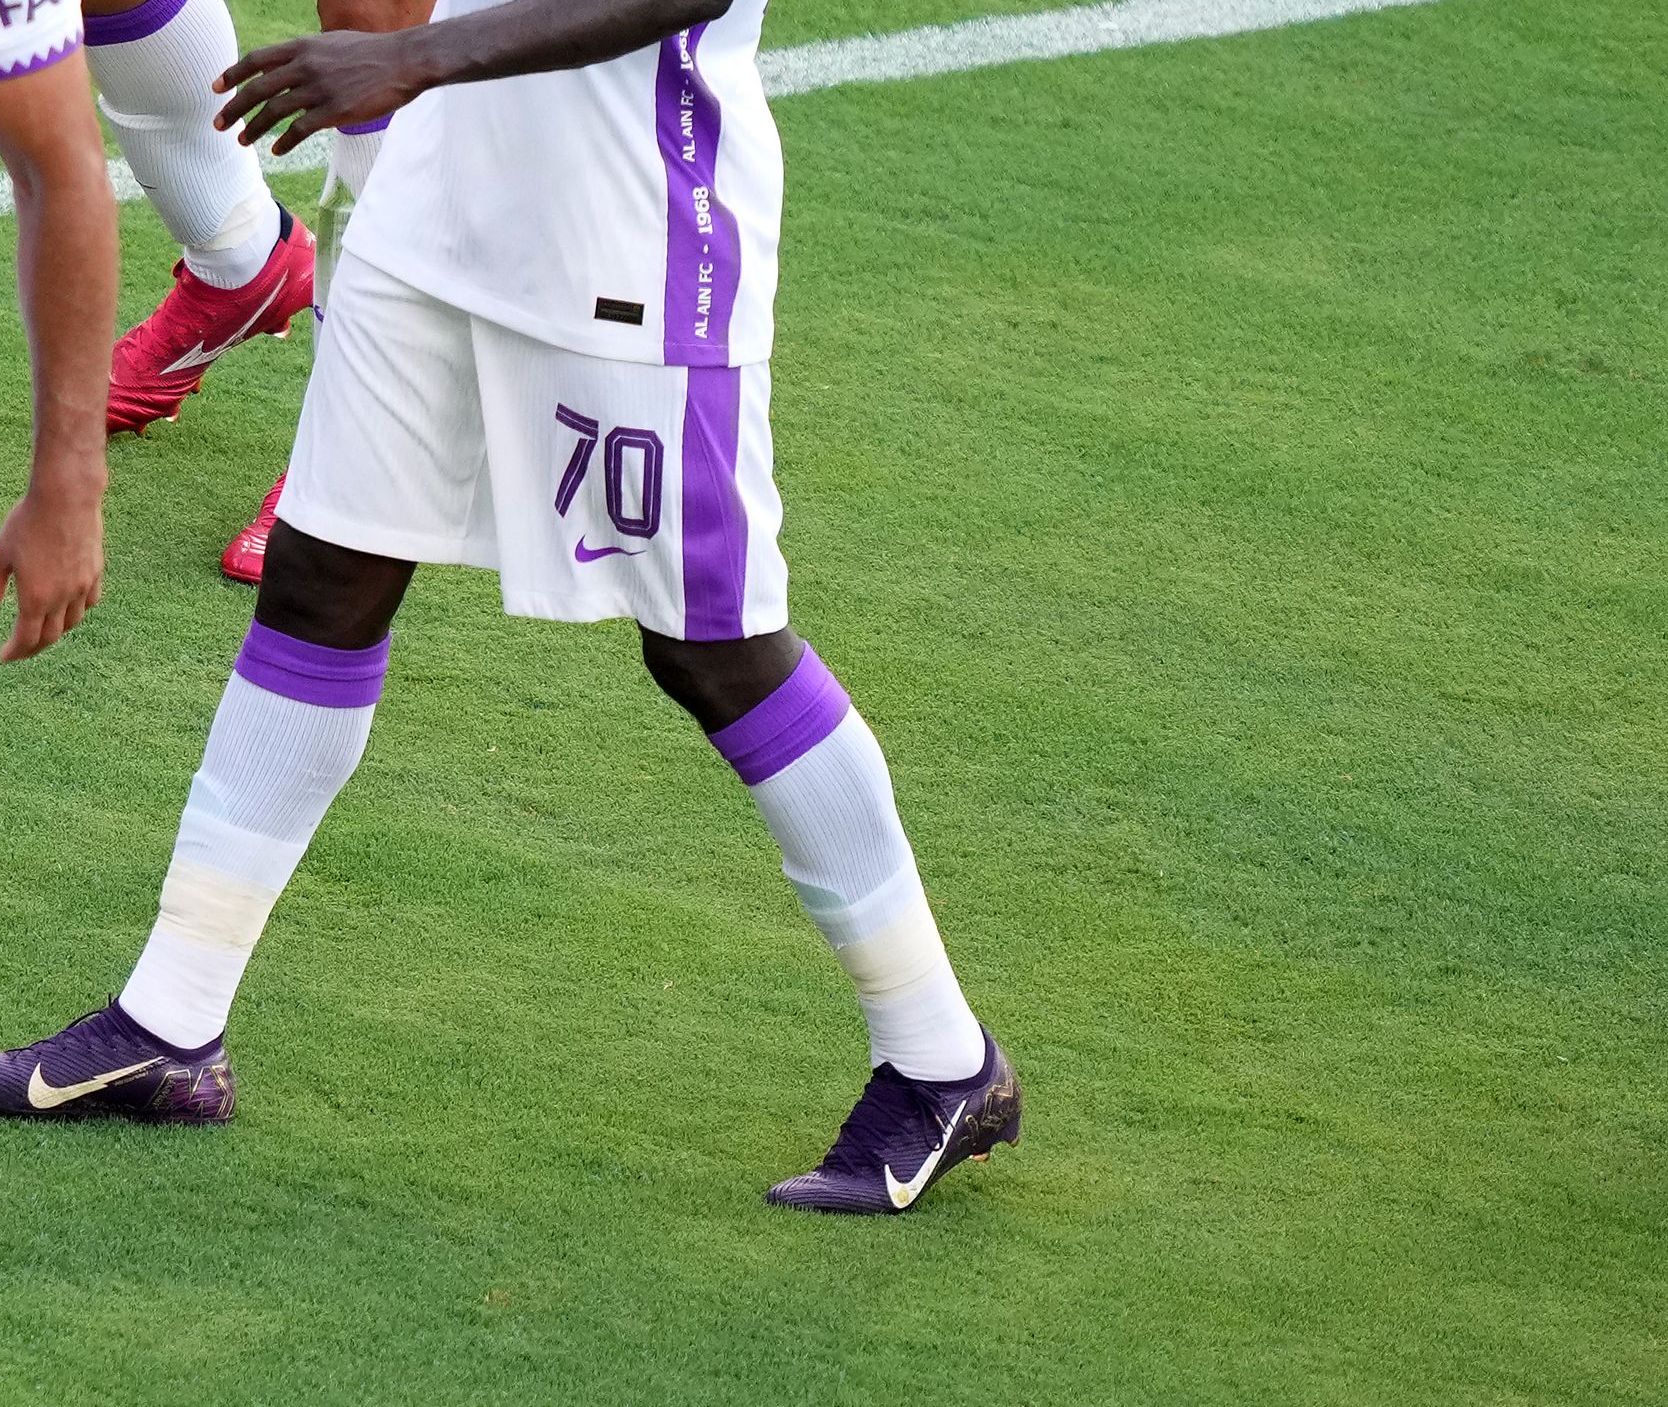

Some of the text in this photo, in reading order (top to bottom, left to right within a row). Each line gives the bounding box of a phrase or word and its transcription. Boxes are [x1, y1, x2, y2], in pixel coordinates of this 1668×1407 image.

[681, 90, 694, 106] FC
[681, 110, 694, 139] AIN
[682, 139, 696, 163] AL
[692, 185, 714, 235] 1968
[698, 262, 714, 284] FC
[696, 288, 713, 317] AIN
[694, 317, 709, 340] AL
[554, 402, 664, 540] 70
